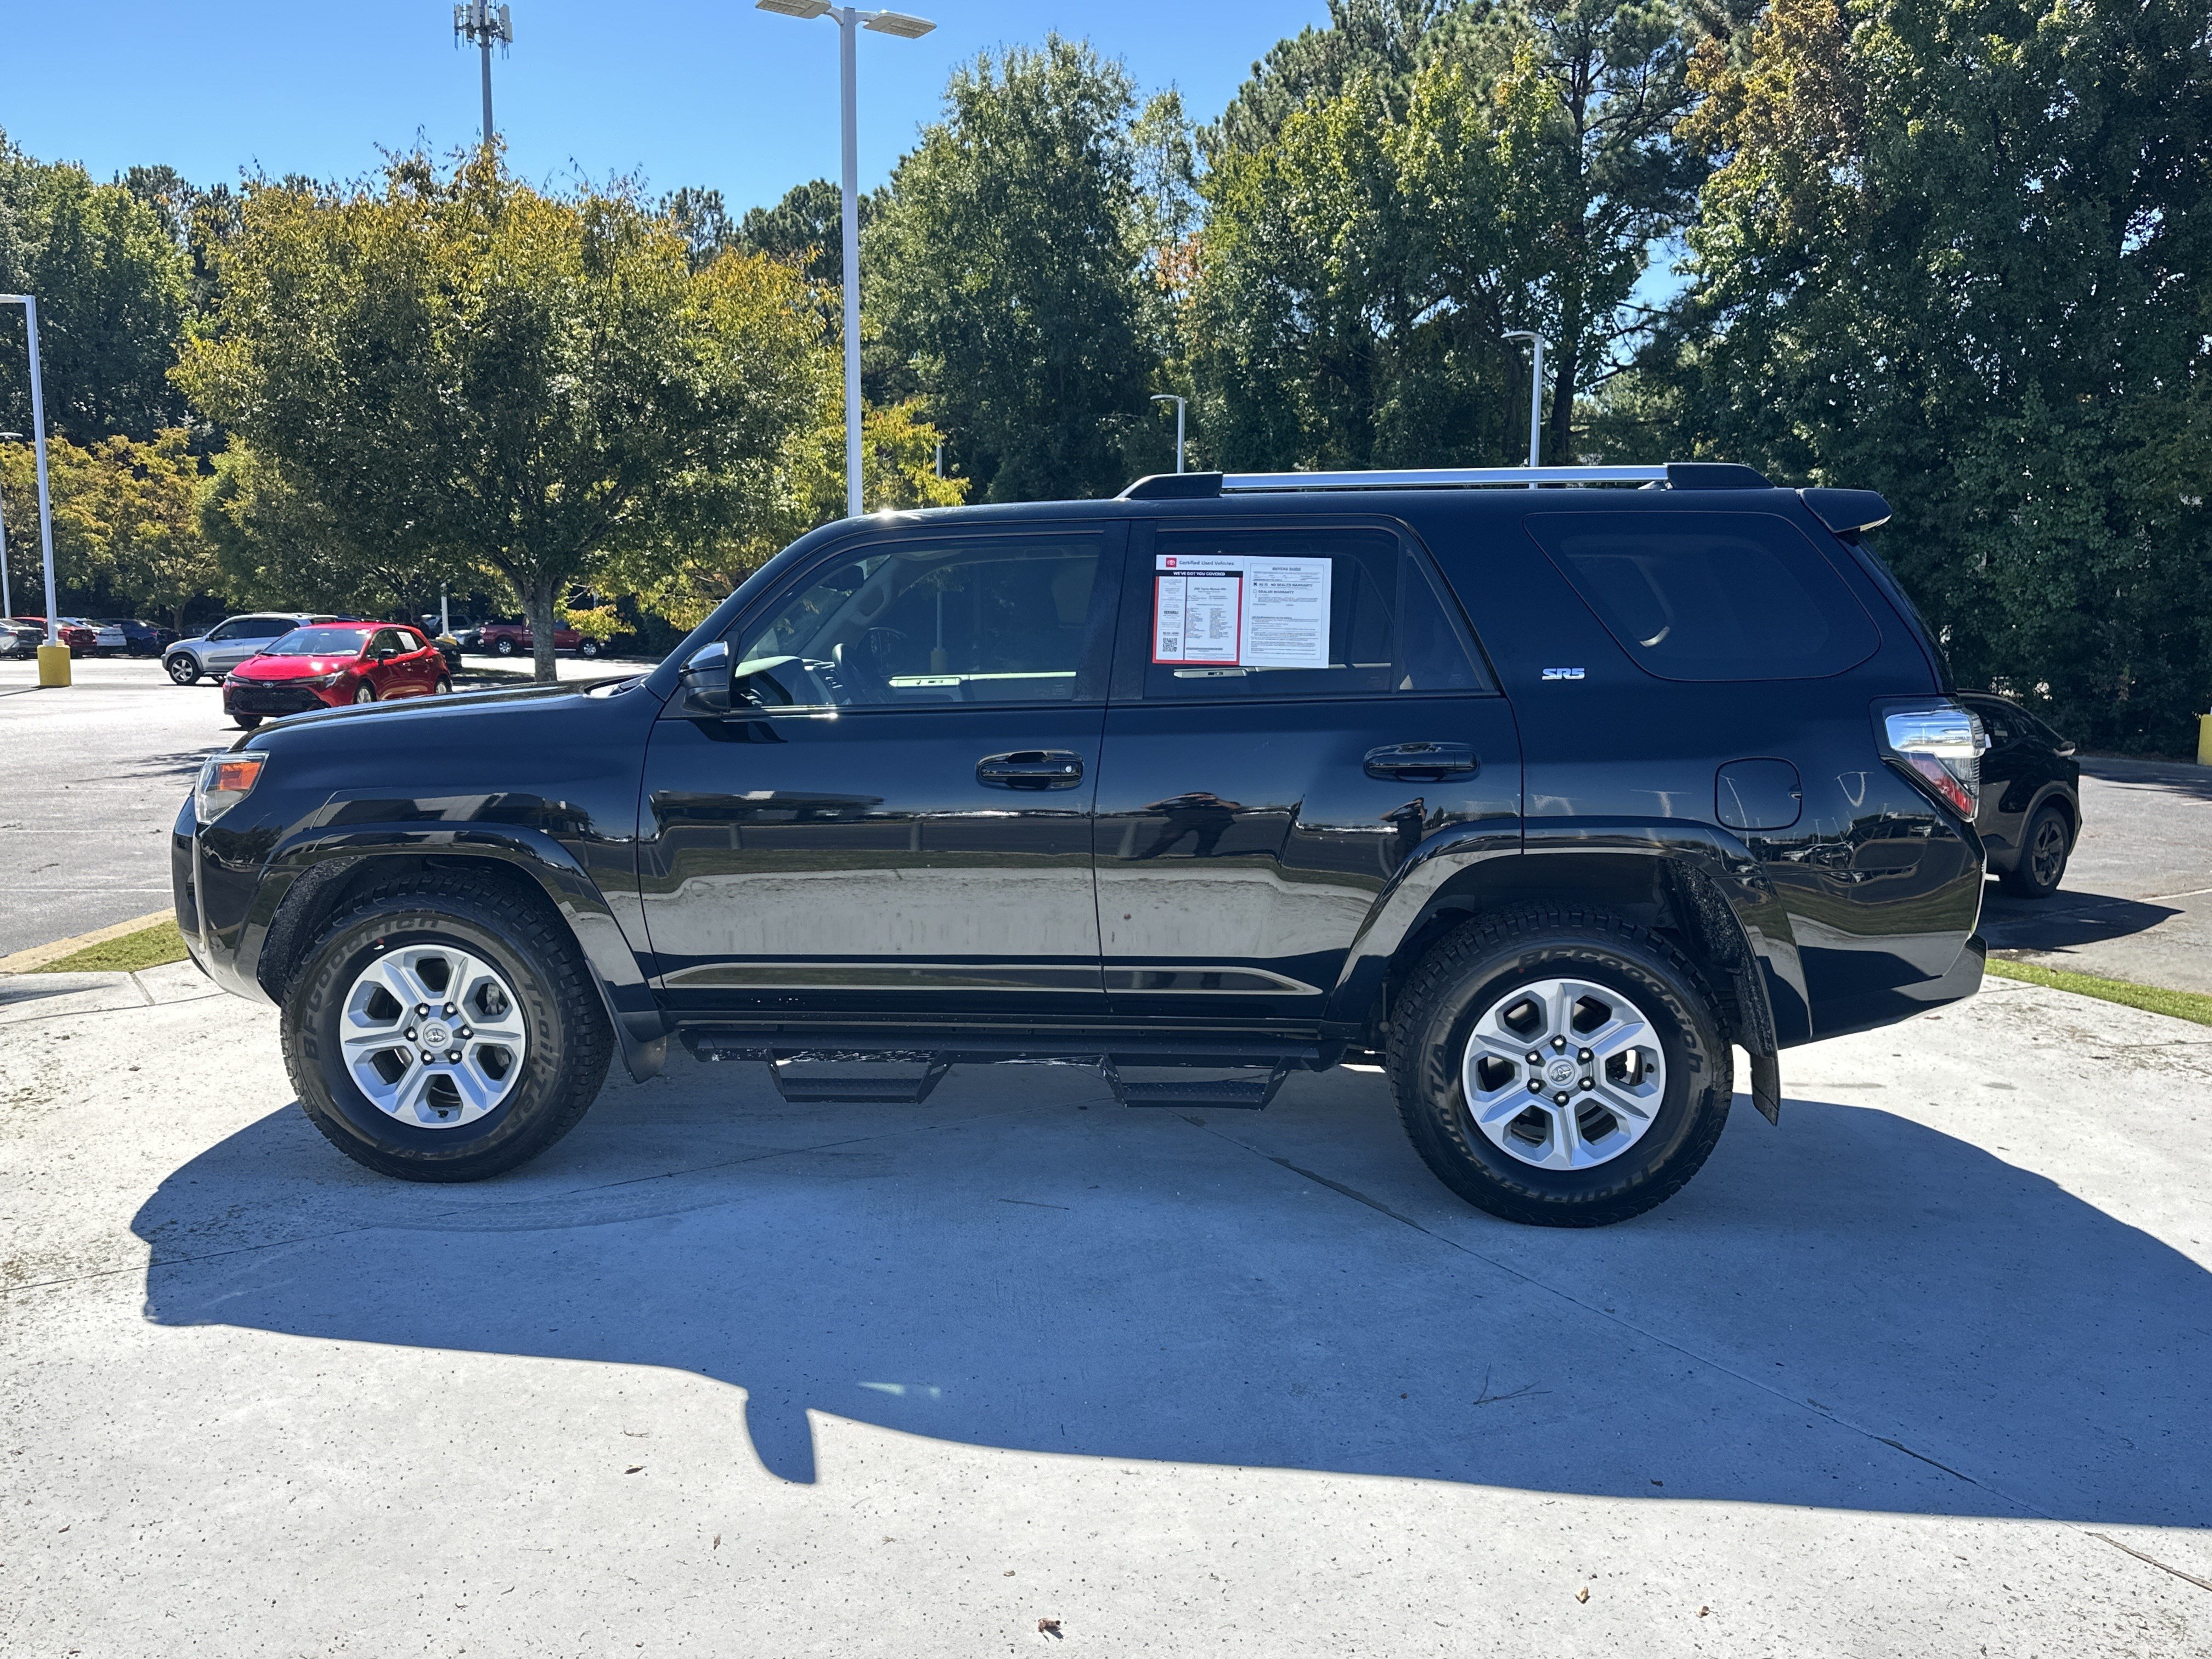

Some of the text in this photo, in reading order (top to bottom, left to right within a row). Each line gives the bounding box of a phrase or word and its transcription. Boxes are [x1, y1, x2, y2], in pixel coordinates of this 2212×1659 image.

[1542, 668, 1585, 680] SR5
[303, 917, 439, 1061] BFGoodrich
[1519, 948, 1703, 1074] BFGoodrich
